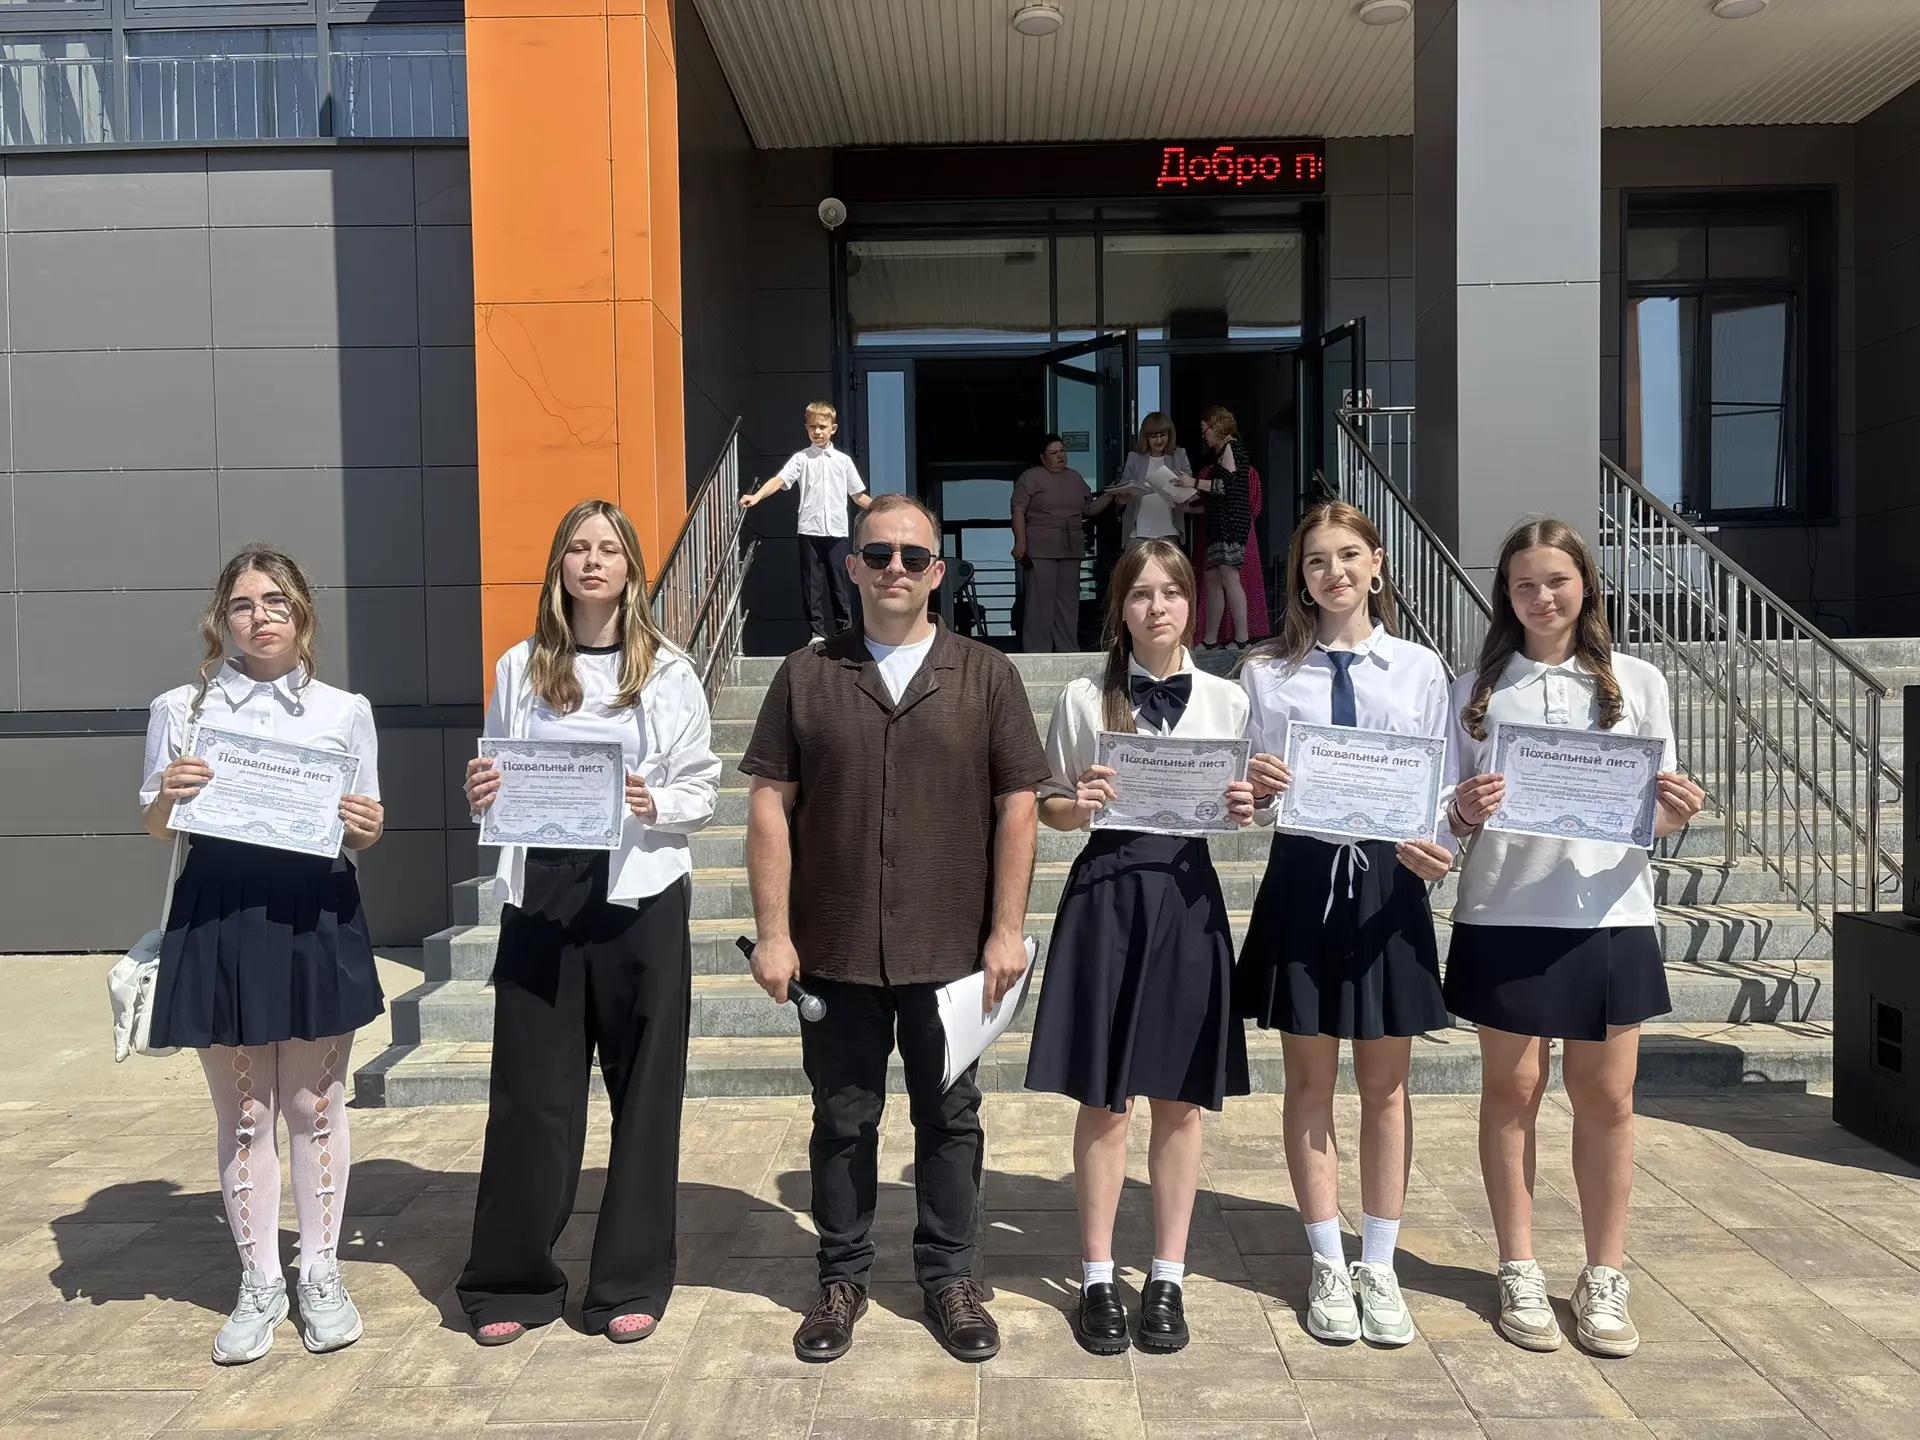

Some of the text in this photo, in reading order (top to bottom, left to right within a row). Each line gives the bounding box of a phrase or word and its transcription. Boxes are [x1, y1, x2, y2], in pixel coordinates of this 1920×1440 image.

[1157, 146, 1322, 187] Добро п
[217, 752, 300, 776] Похвальный
[303, 771, 335, 783] лист
[503, 761, 605, 773] Похвальный лист
[1120, 753, 1195, 768] Похвальный
[1199, 760, 1227, 768] лист
[1311, 746, 1388, 765] Похвальный
[1392, 757, 1421, 768] лист
[1519, 747, 1602, 766] Похвальный
[1606, 757, 1638, 769] лист
